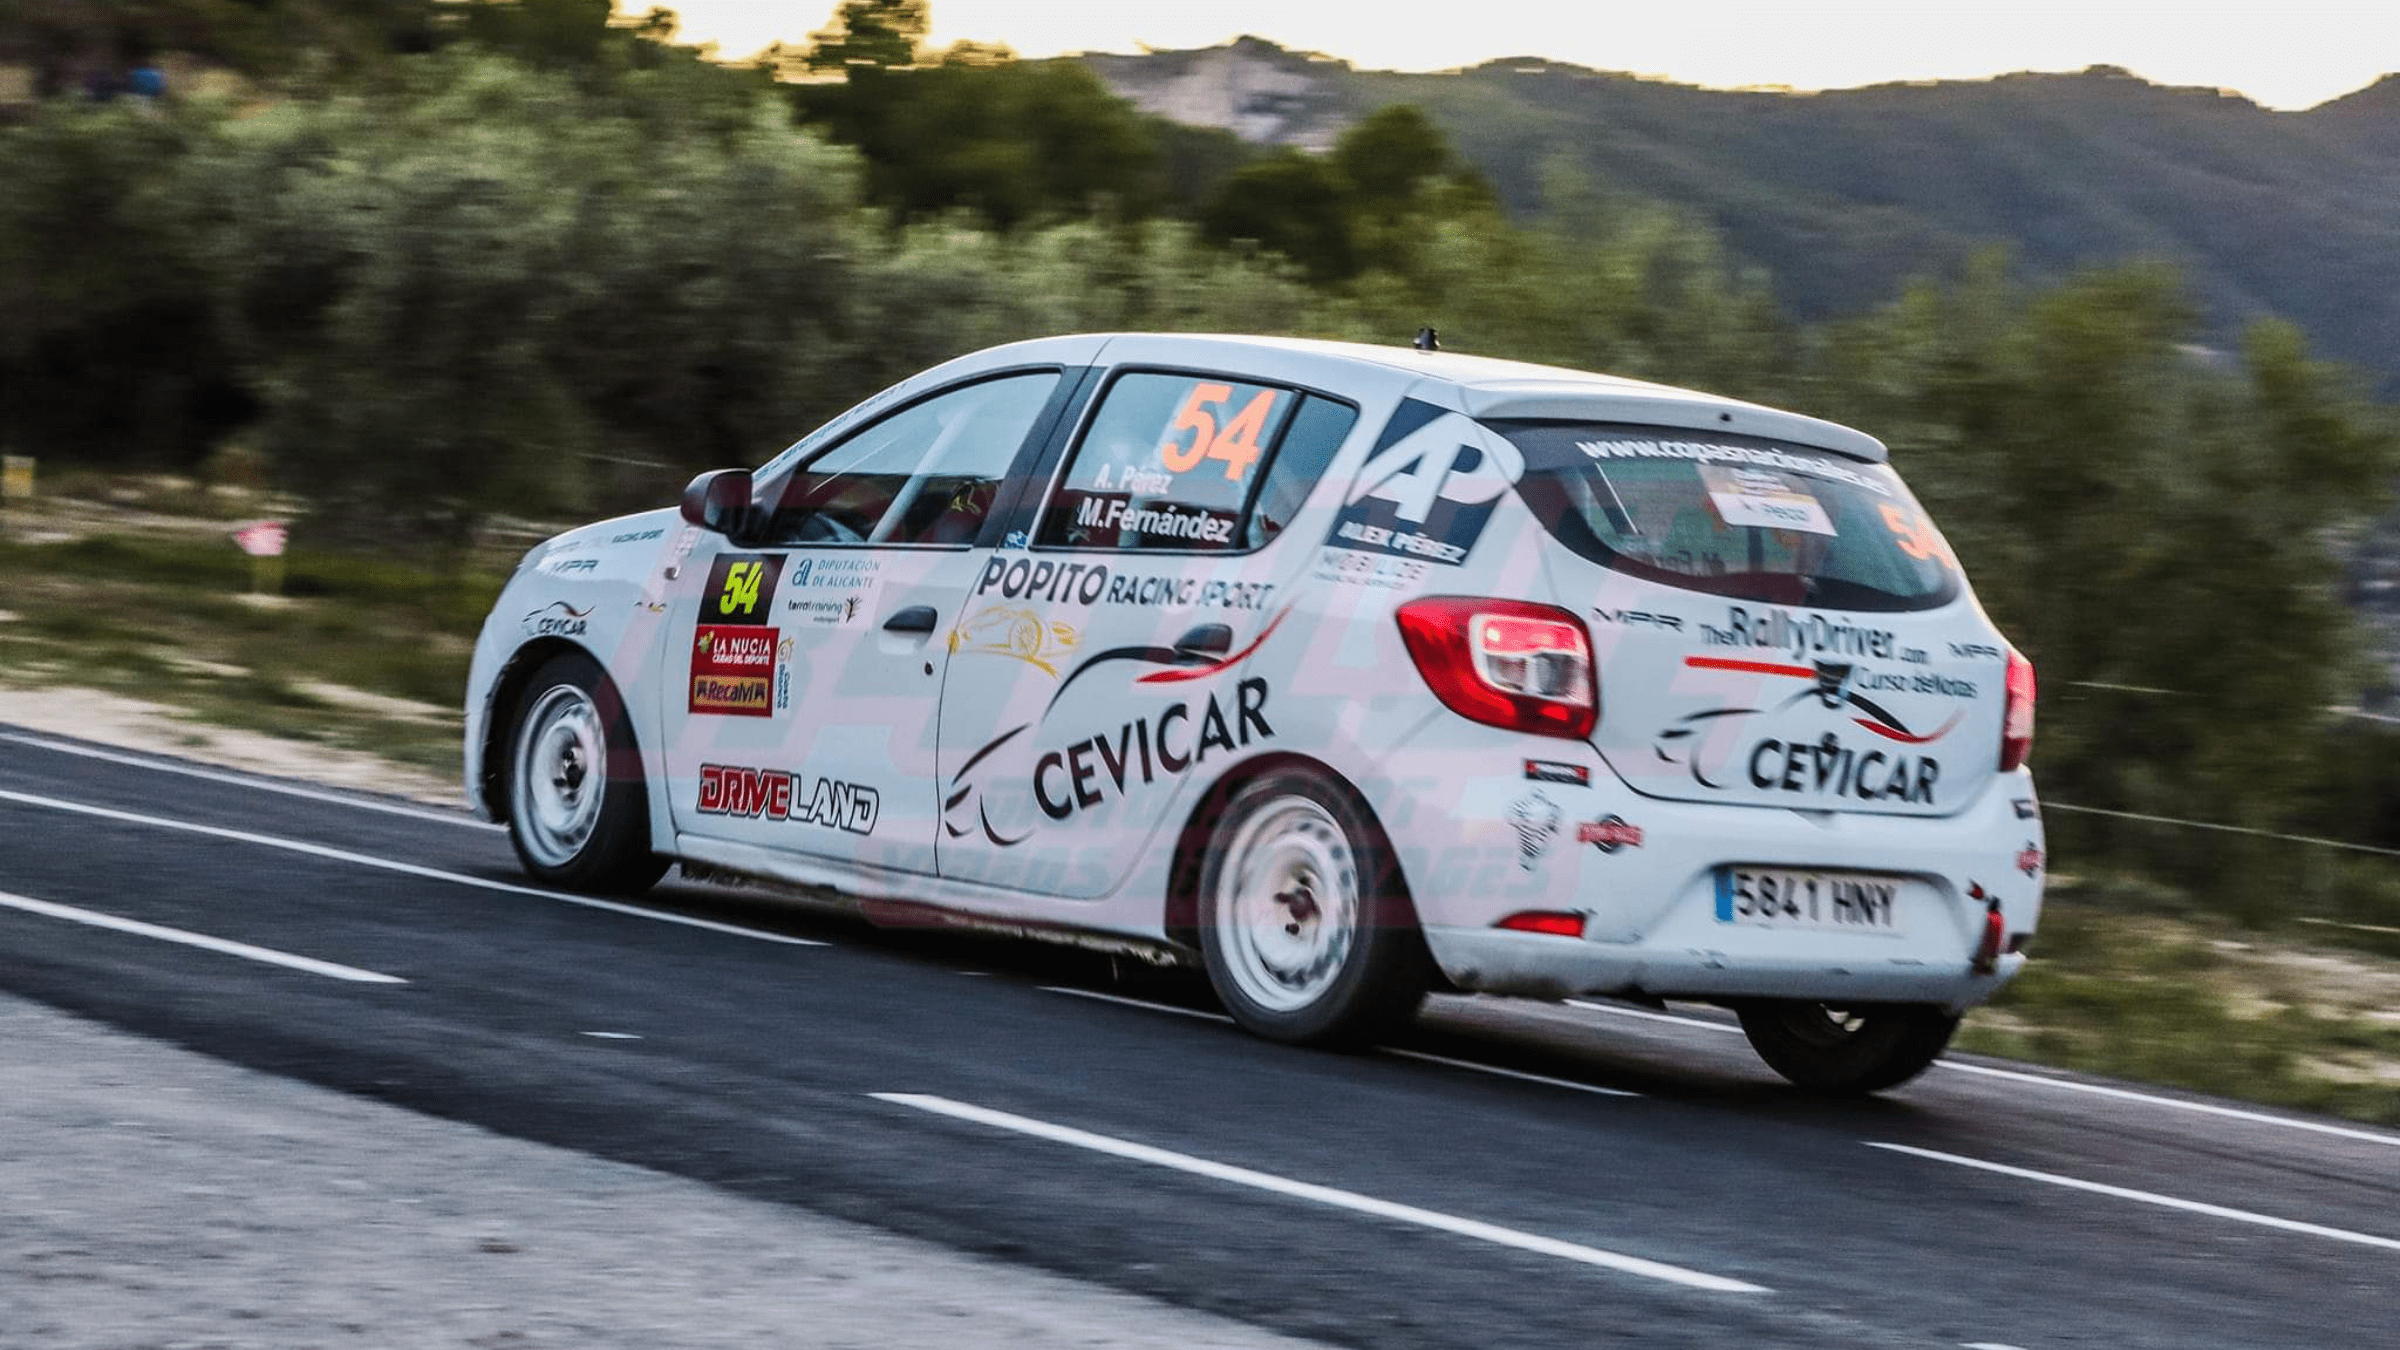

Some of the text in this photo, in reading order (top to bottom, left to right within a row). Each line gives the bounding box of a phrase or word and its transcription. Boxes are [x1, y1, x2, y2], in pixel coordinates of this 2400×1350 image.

[1162, 382, 1277, 482] 54
[1093, 463, 1112, 488] A.
[1076, 496, 1235, 544] M.Fernández
[1337, 520, 1468, 564] ALEX PÉREZ
[719, 561, 764, 615] 54
[812, 577, 874, 589] DE ALICANTE
[976, 556, 1278, 612] POPITO RACING SPORT
[538, 618, 588, 635] CEVICAR
[788, 599, 843, 614] terratraining
[1592, 606, 1686, 634] MPR
[713, 637, 771, 655] LA NUCIA
[744, 654, 771, 666] DEPORTE
[1034, 676, 1277, 820] CEVICAR
[1749, 738, 1942, 806] CEVICAR
[696, 763, 880, 836] DRIVELAND
[1734, 871, 1897, 928] 5841 HNY
